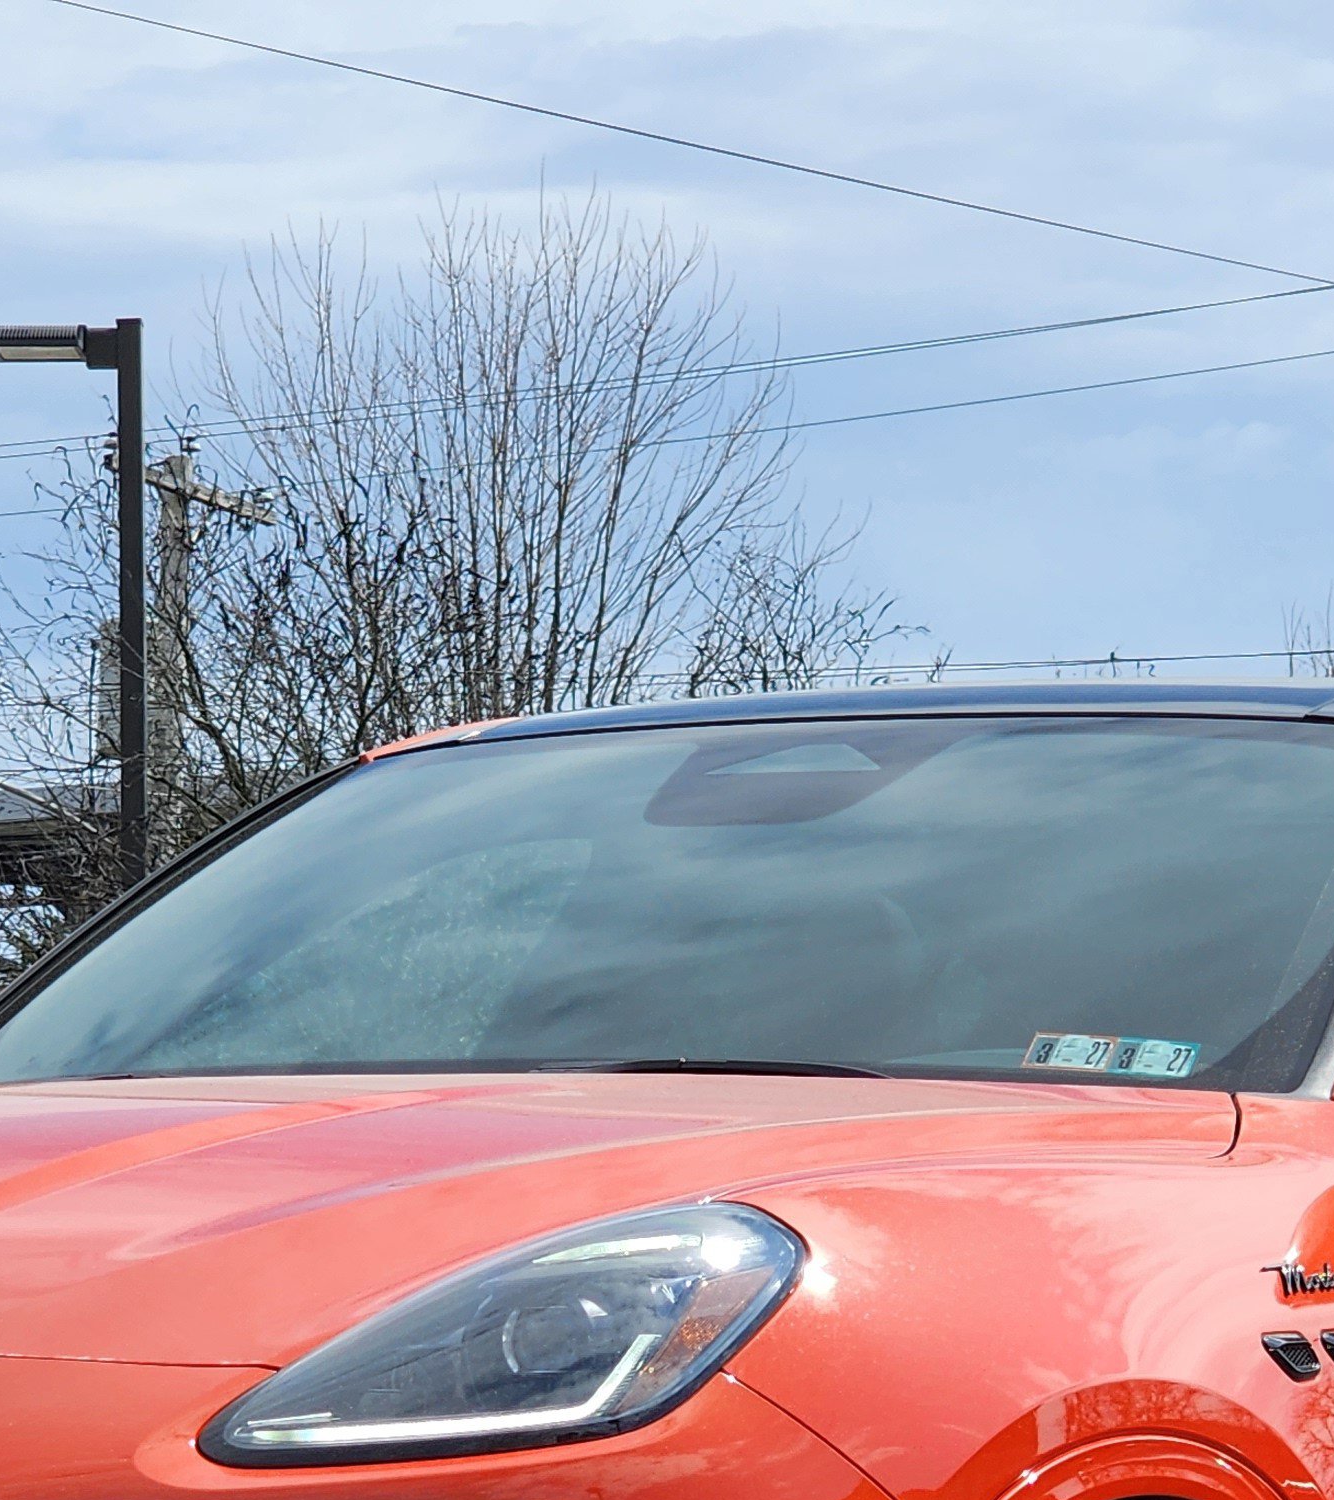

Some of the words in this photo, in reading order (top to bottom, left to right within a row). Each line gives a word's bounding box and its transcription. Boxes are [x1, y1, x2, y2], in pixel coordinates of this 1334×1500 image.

[1035, 1042, 1054, 1064] 3
[1084, 1040, 1111, 1068] 27
[1118, 1047, 1136, 1069] 3
[1166, 1047, 1192, 1074] 27
